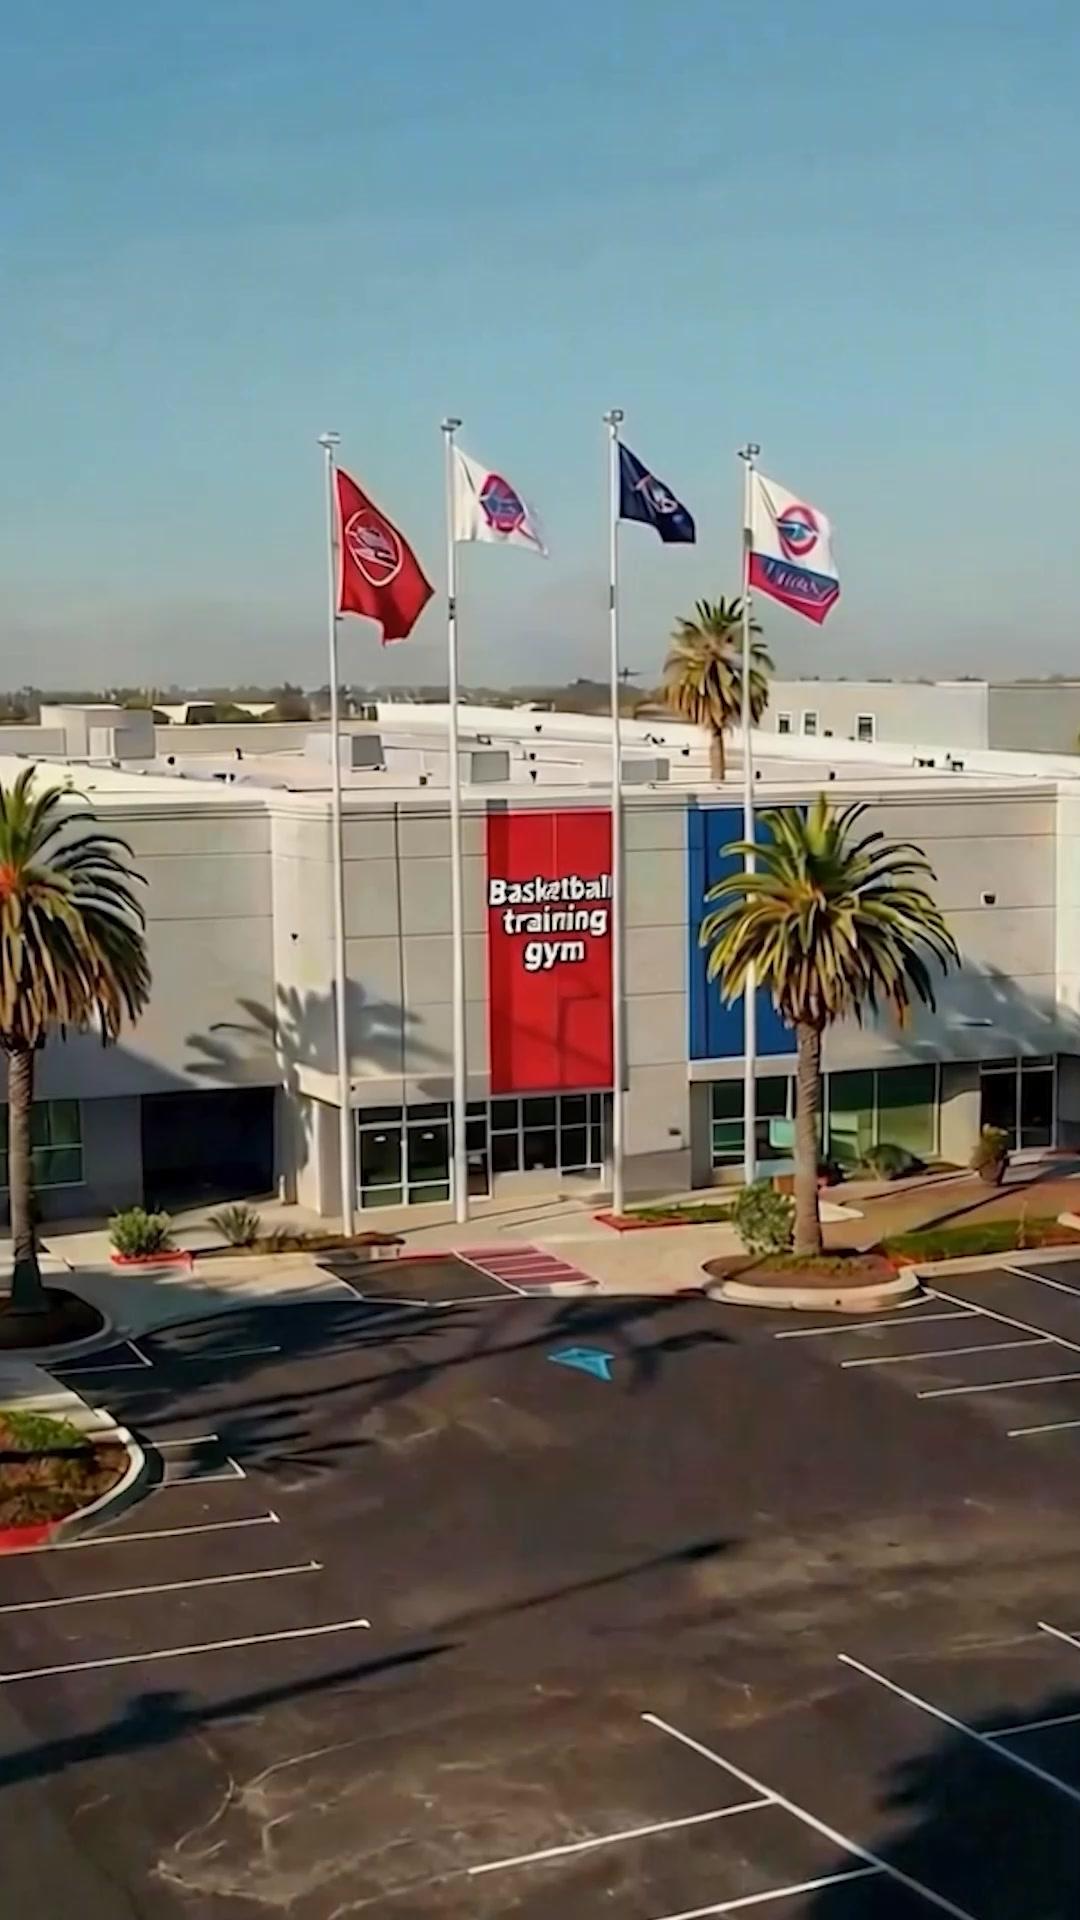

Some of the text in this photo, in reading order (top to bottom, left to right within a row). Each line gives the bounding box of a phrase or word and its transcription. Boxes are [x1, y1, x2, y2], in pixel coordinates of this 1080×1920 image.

[489, 874, 611, 905] Basketball
[503, 903, 607, 936] training
[525, 941, 584, 971] gym
